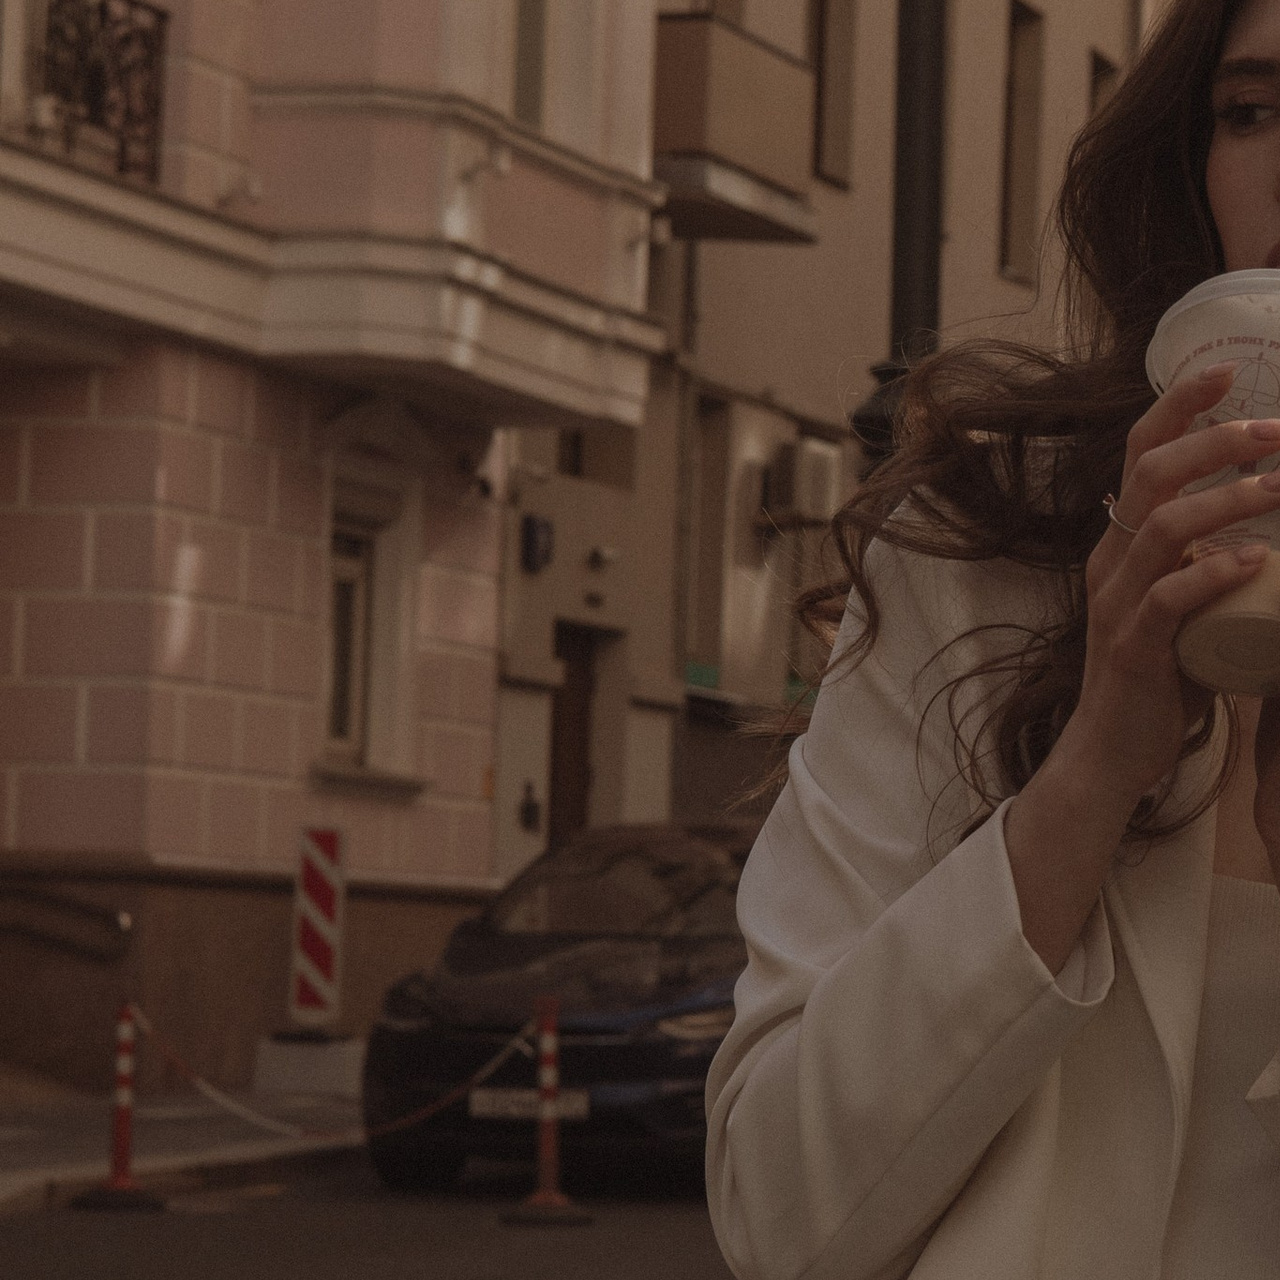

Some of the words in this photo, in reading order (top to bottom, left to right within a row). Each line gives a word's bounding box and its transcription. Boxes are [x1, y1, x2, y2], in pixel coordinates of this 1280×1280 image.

[1193, 342, 1214, 357] УЖЕ
[1216, 339, 1224, 347] В
[1227, 336, 1265, 346] ТВОИХ
